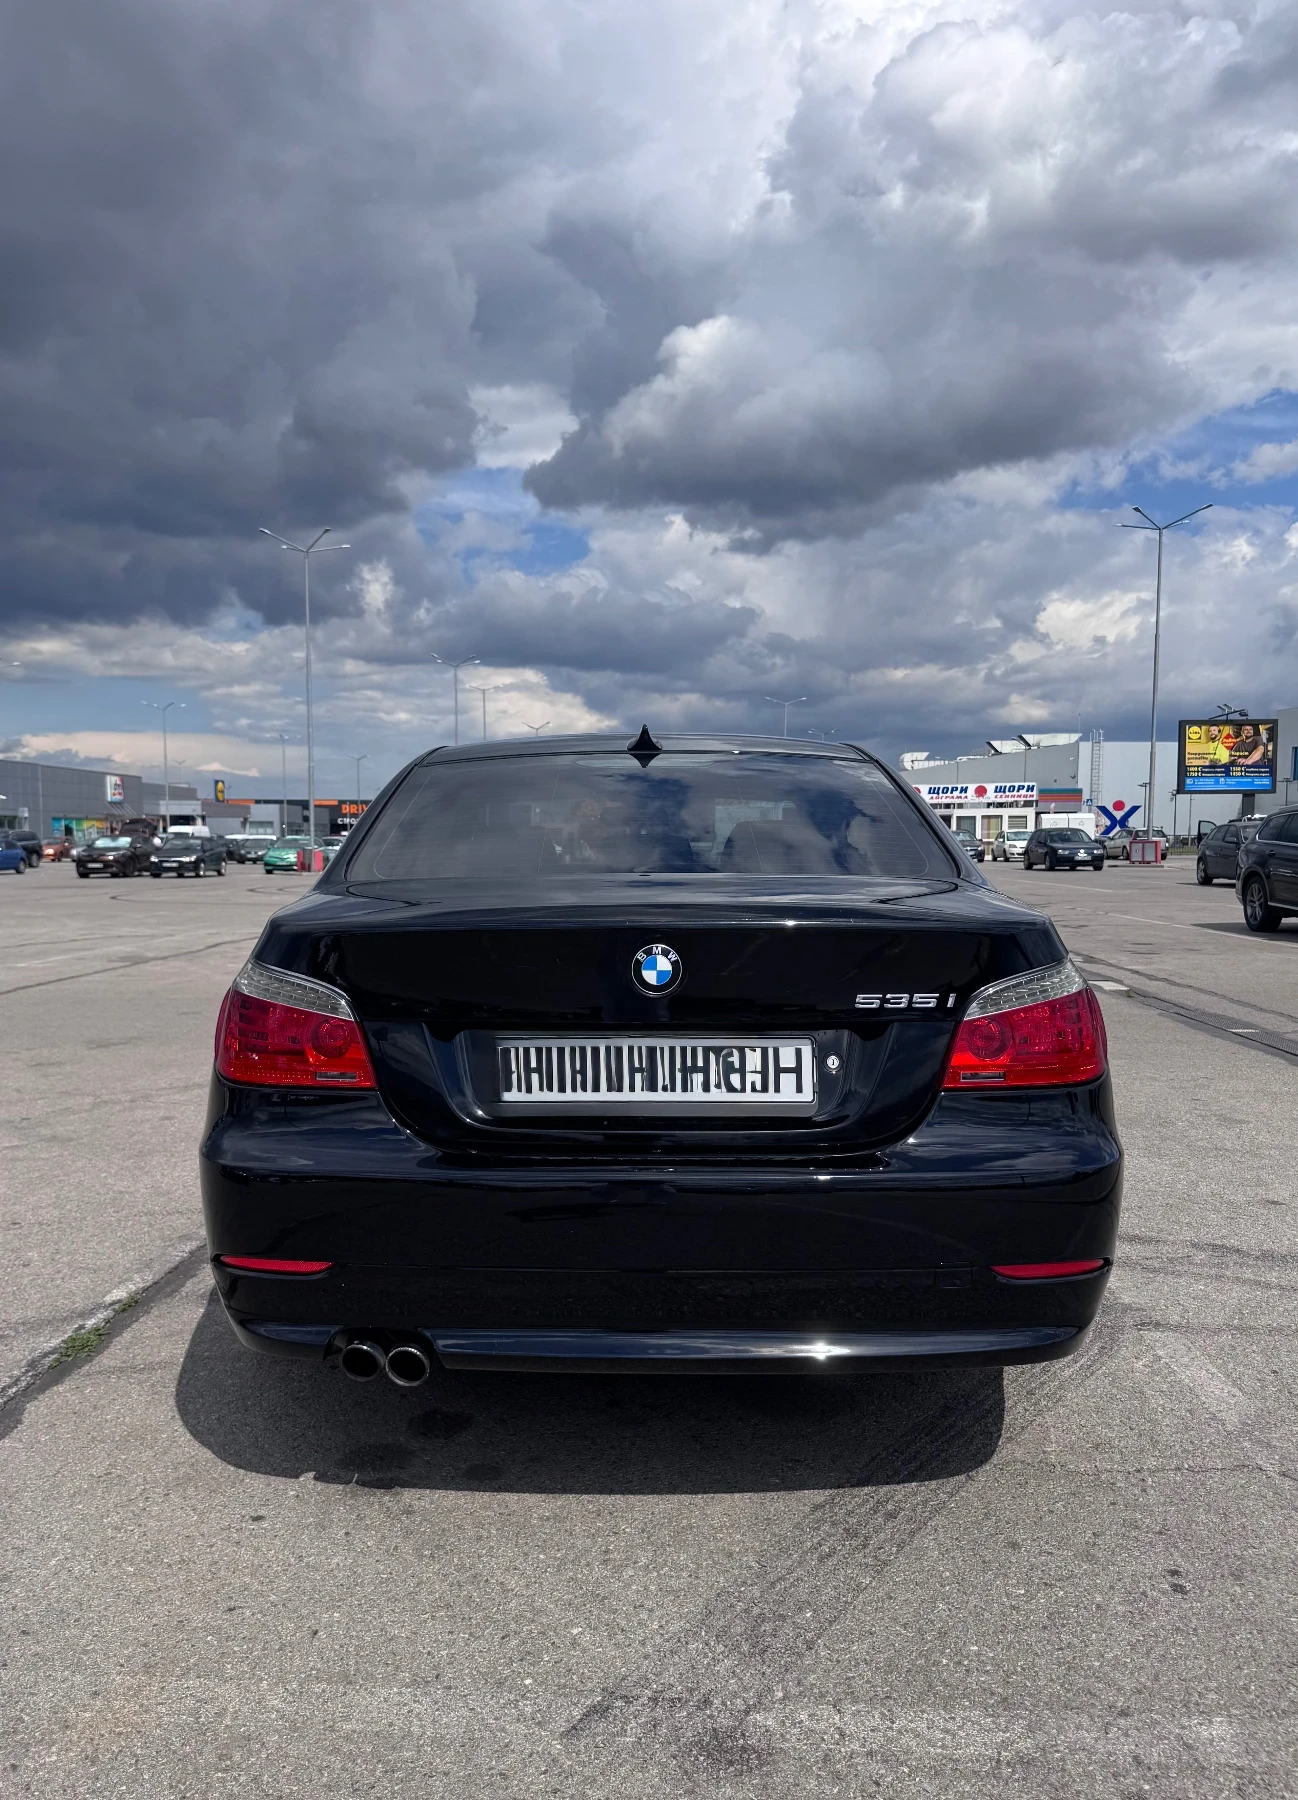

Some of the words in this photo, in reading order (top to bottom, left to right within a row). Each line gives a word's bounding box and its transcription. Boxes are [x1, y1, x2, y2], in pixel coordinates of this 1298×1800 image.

[927, 786, 969, 795] ЩОРИ
[993, 785, 1036, 794] ЩОРИ
[637, 946, 678, 963] BMW
[854, 993, 957, 1008] 535i
